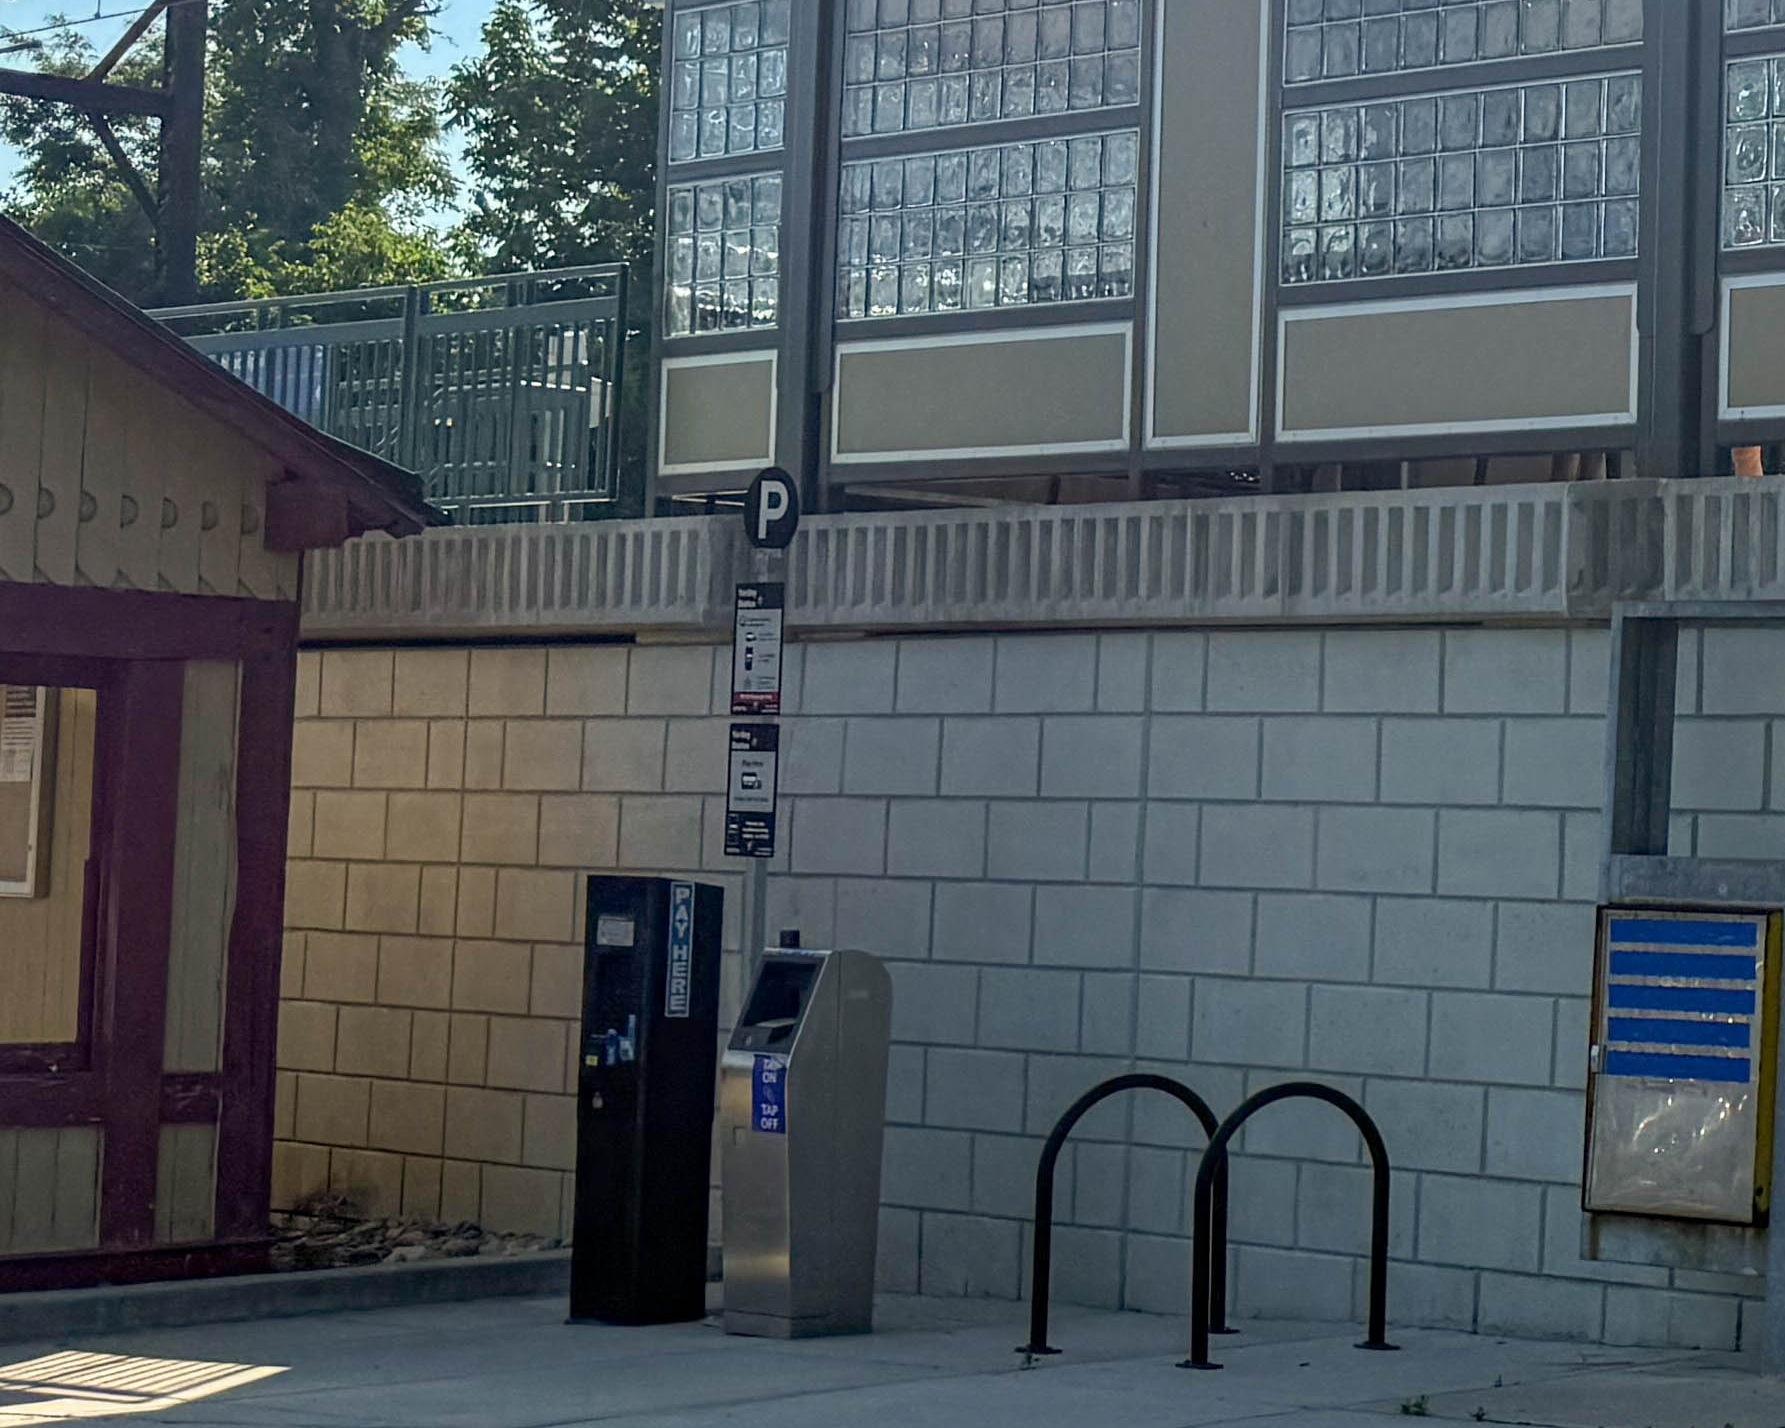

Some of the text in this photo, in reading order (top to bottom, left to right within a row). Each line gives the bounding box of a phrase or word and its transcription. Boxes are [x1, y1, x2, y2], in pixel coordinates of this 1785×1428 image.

[757, 480, 789, 540] P
[670, 887, 690, 1010] PAY HERE
[762, 1072, 777, 1083] ON
[761, 1104, 778, 1116] TAP
[761, 1117, 778, 1129] OFF
